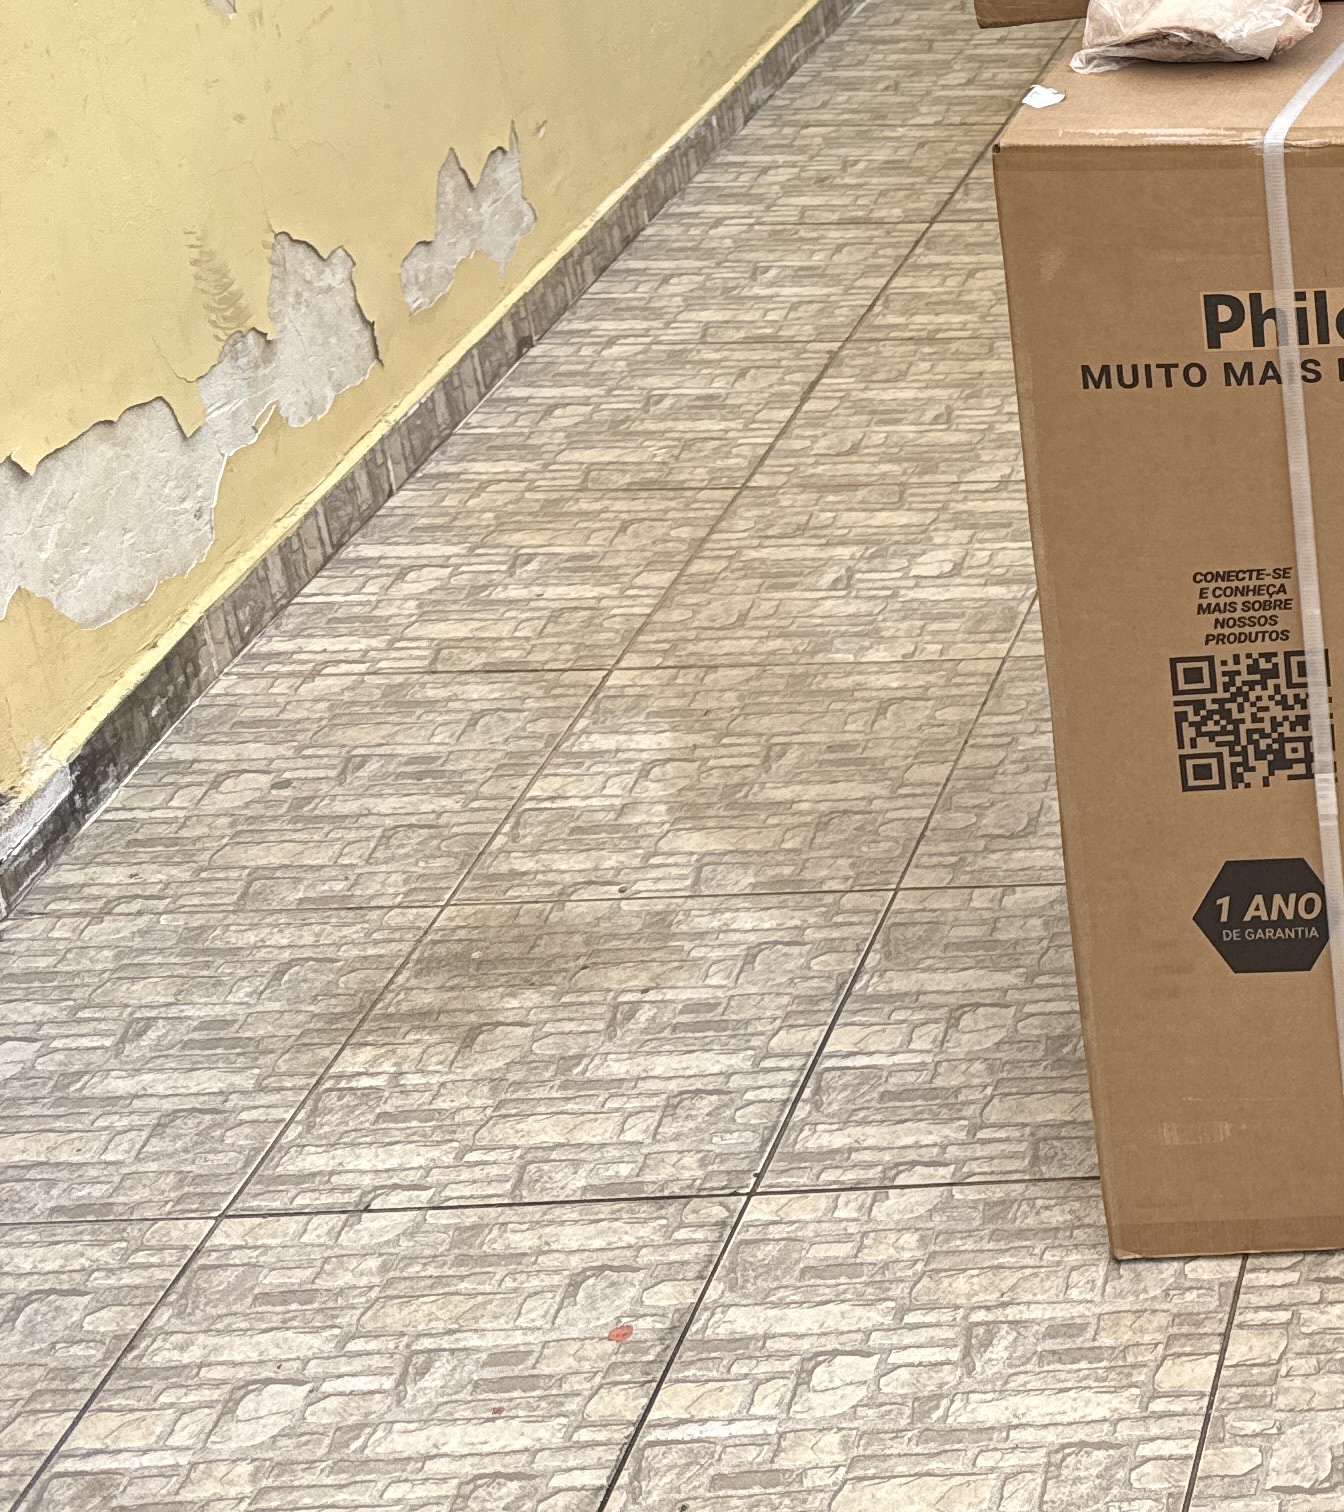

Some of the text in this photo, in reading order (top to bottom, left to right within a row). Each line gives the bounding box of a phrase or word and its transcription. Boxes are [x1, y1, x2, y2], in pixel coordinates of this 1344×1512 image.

[1080, 363, 1207, 390] MUITO
[1223, 358, 1322, 386] MAS
[1192, 567, 1293, 584] CONECTE-SE
[1199, 583, 1288, 599] E CONHEÇA
[1196, 598, 1294, 615] MAIS SOBRE
[1214, 615, 1279, 629] NOSSOS
[1204, 629, 1291, 645] PRODUTOS
[1216, 892, 1322, 922] 1 ANO
[1222, 926, 1319, 941] DE GARANTIA
